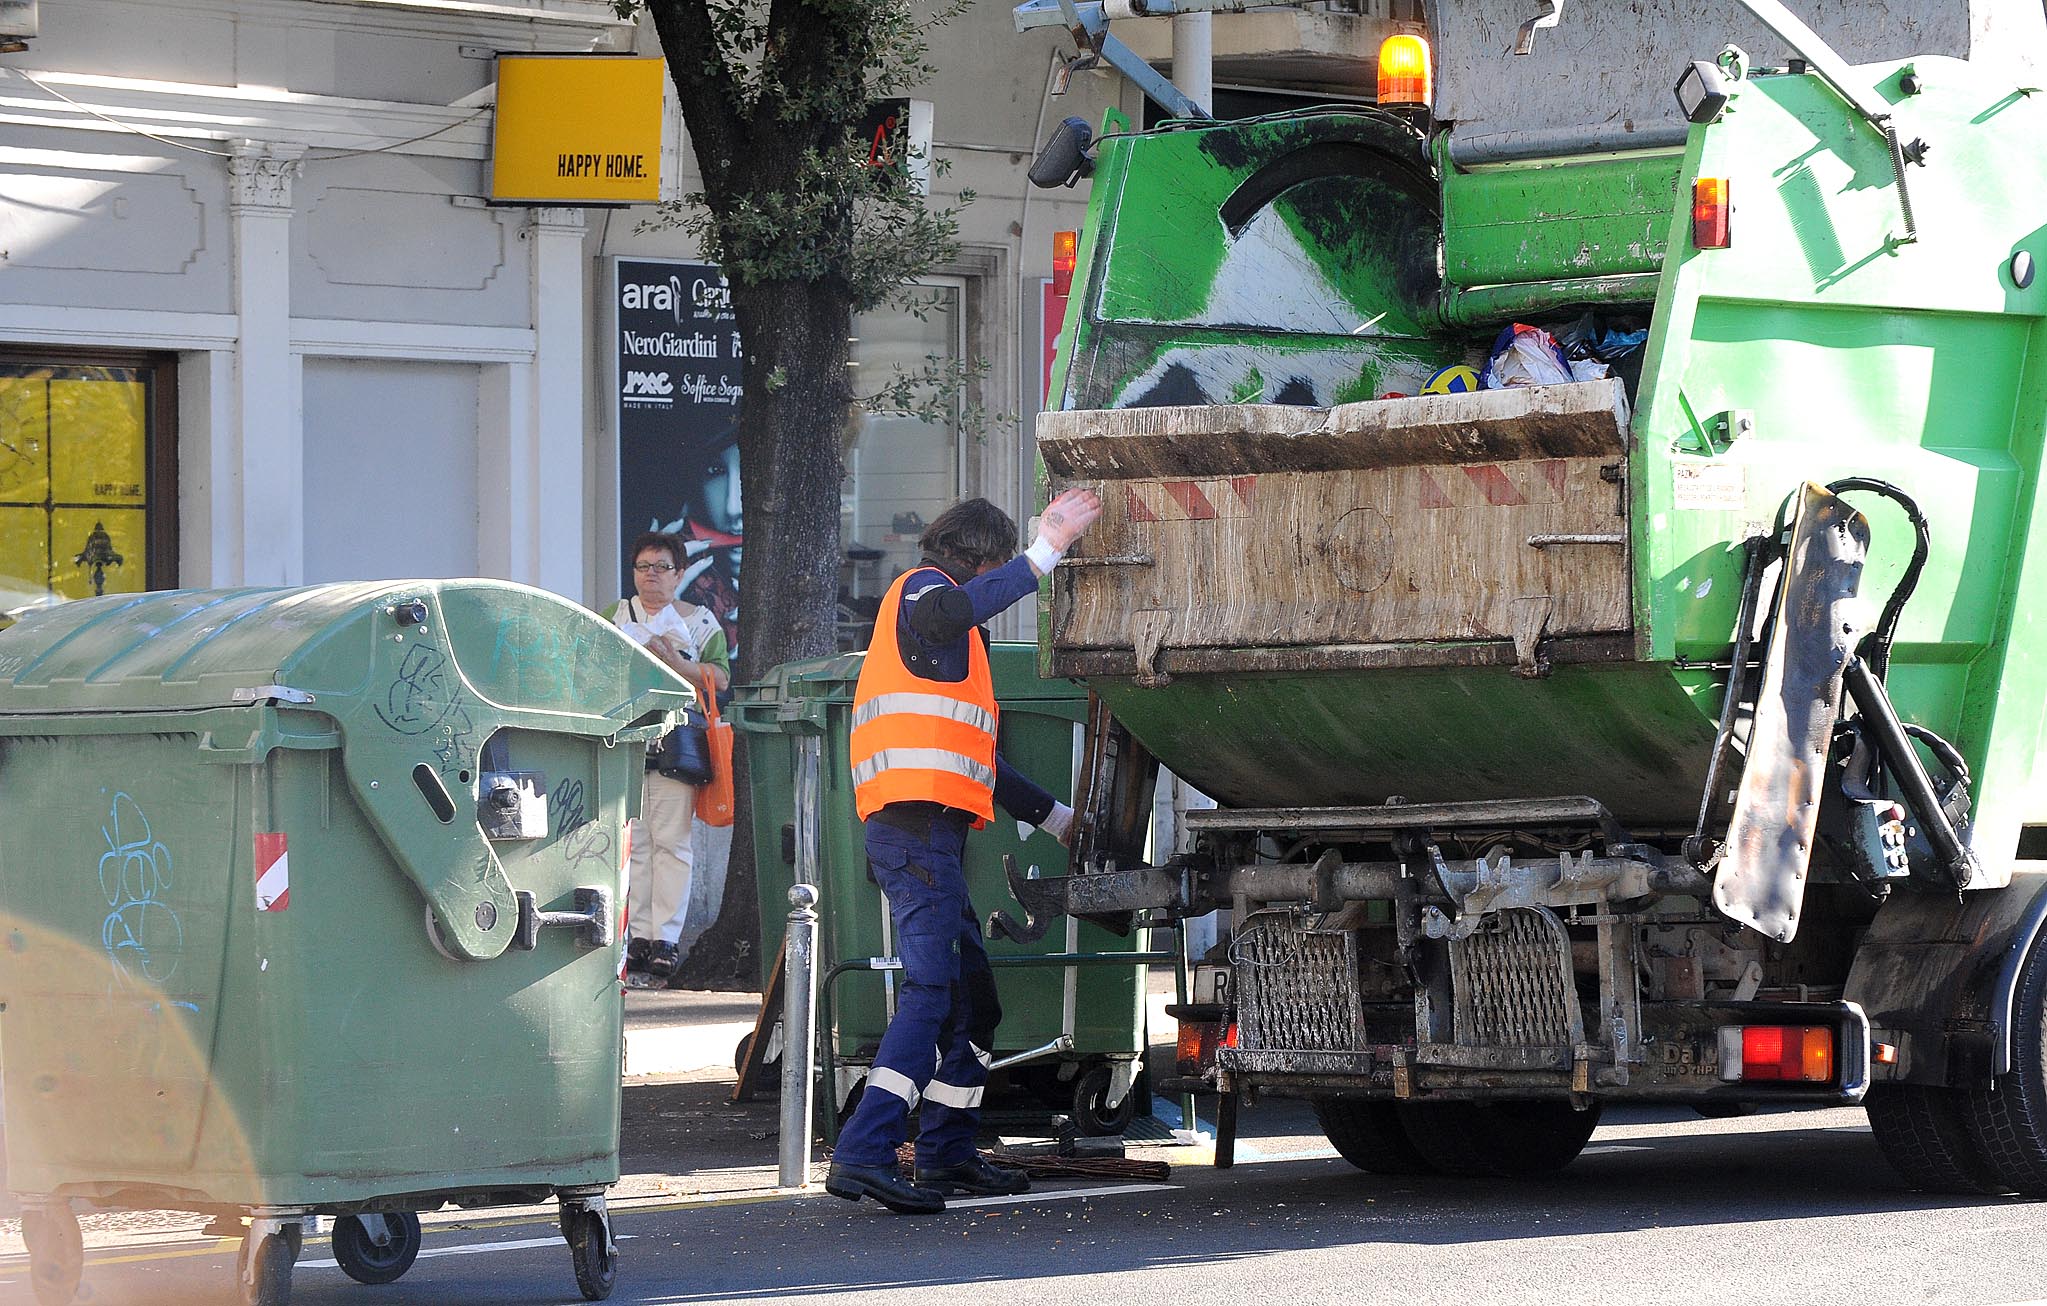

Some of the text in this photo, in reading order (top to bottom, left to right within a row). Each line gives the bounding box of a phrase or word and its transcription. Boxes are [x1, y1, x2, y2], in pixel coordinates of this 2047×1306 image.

[557, 154, 648, 178] HAPPY HOME.
[622, 283, 672, 310] ara
[623, 330, 718, 358] NeroGiardini
[681, 373, 717, 404] Soffice
